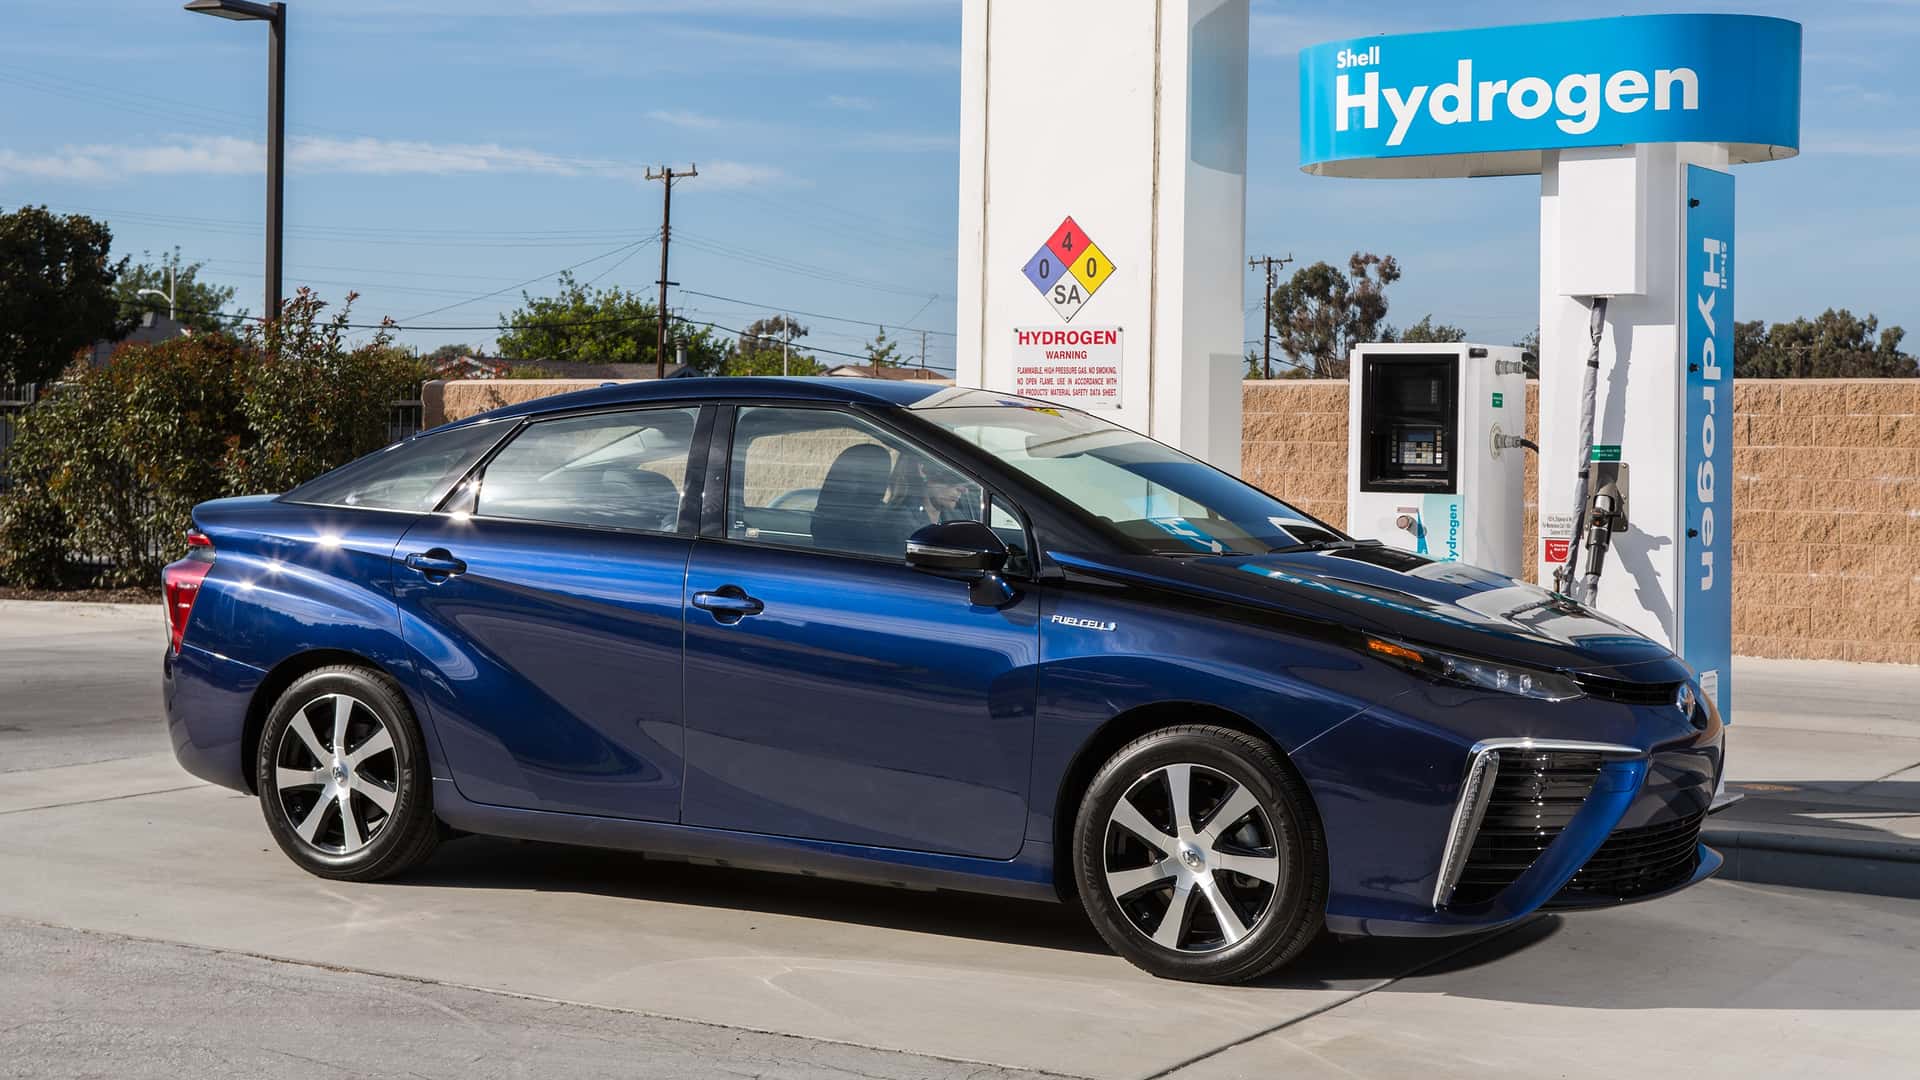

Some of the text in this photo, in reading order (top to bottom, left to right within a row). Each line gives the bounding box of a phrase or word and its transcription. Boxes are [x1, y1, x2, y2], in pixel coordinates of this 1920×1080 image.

[1336, 46, 1380, 69] Shell
[1335, 59, 1699, 146] Hydrogen
[1062, 231, 1073, 251] 4
[1039, 257, 1097, 279] 0 0
[1054, 284, 1081, 304] SA
[1018, 330, 1117, 345] HYDROGEN
[1045, 351, 1087, 360] WARNING
[1055, 366, 1077, 375] PRESSURE
[1088, 366, 1095, 375] NO
[1017, 377, 1023, 385] NO
[1026, 377, 1037, 385] OPEN
[1057, 377, 1065, 385] USE
[1067, 377, 1072, 385] IN
[1075, 377, 1104, 385] ACCORDANCE
[1106, 377, 1118, 385] WITH
[1050, 388, 1071, 396] MATERIAL
[1072, 388, 1088, 396] SAFETY
[1090, 388, 1101, 396] DATA
[1697, 237, 1721, 592] Hydrogen
